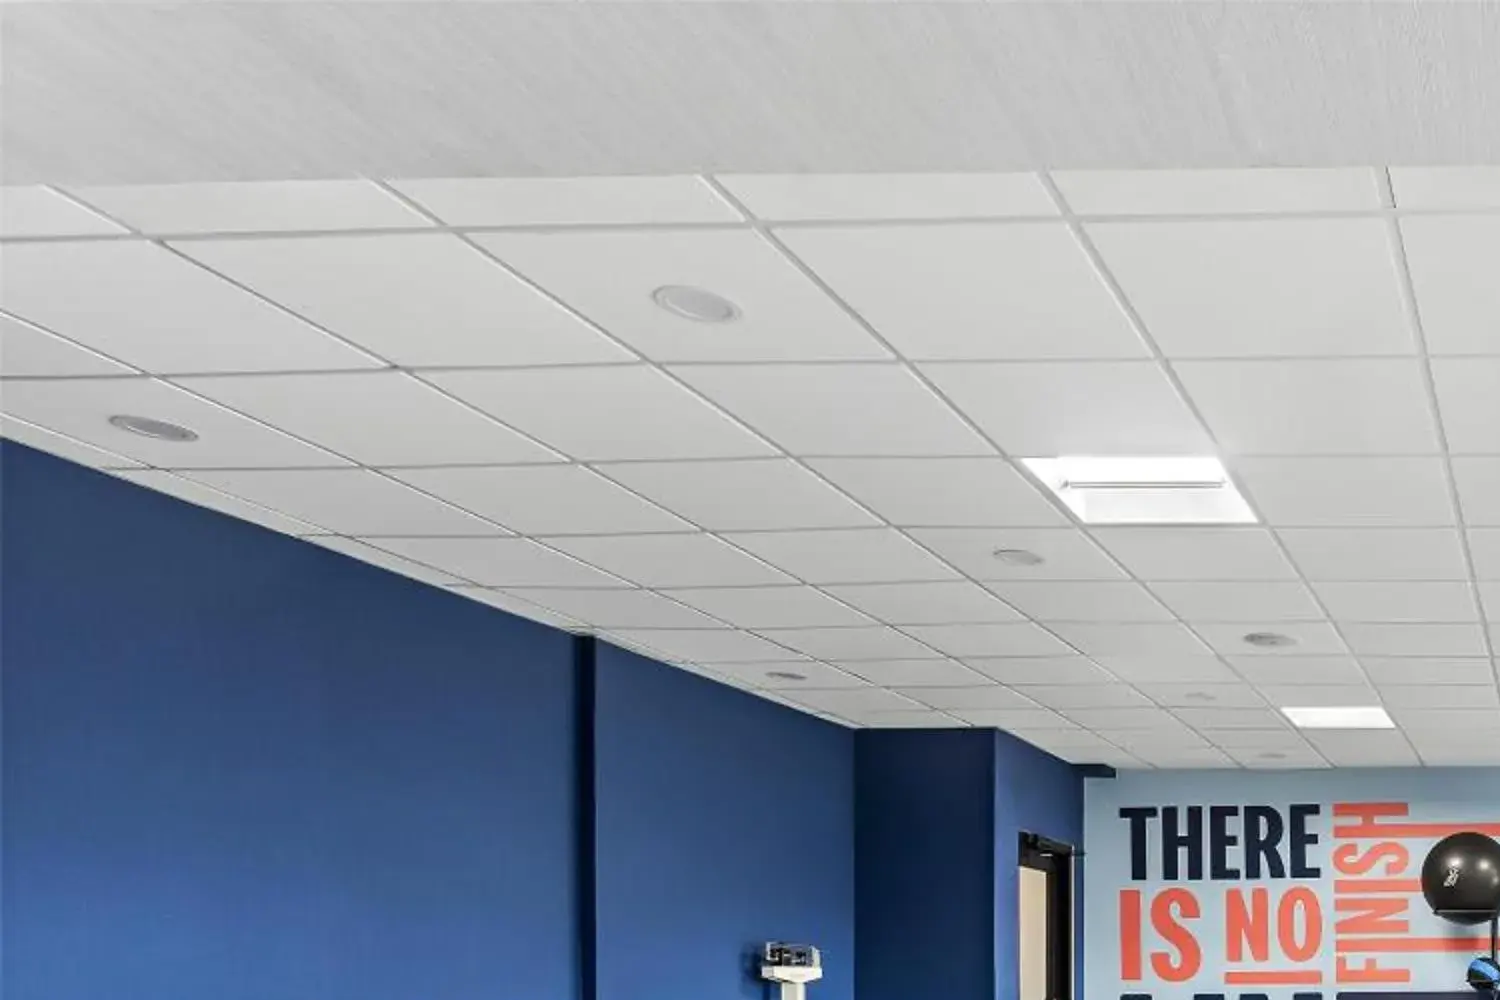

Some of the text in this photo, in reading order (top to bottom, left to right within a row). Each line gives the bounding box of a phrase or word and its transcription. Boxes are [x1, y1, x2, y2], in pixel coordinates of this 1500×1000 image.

[1119, 803, 1321, 881] THERE
[1119, 886, 1323, 982] IS NO
[1331, 802, 1411, 983] FINISH
